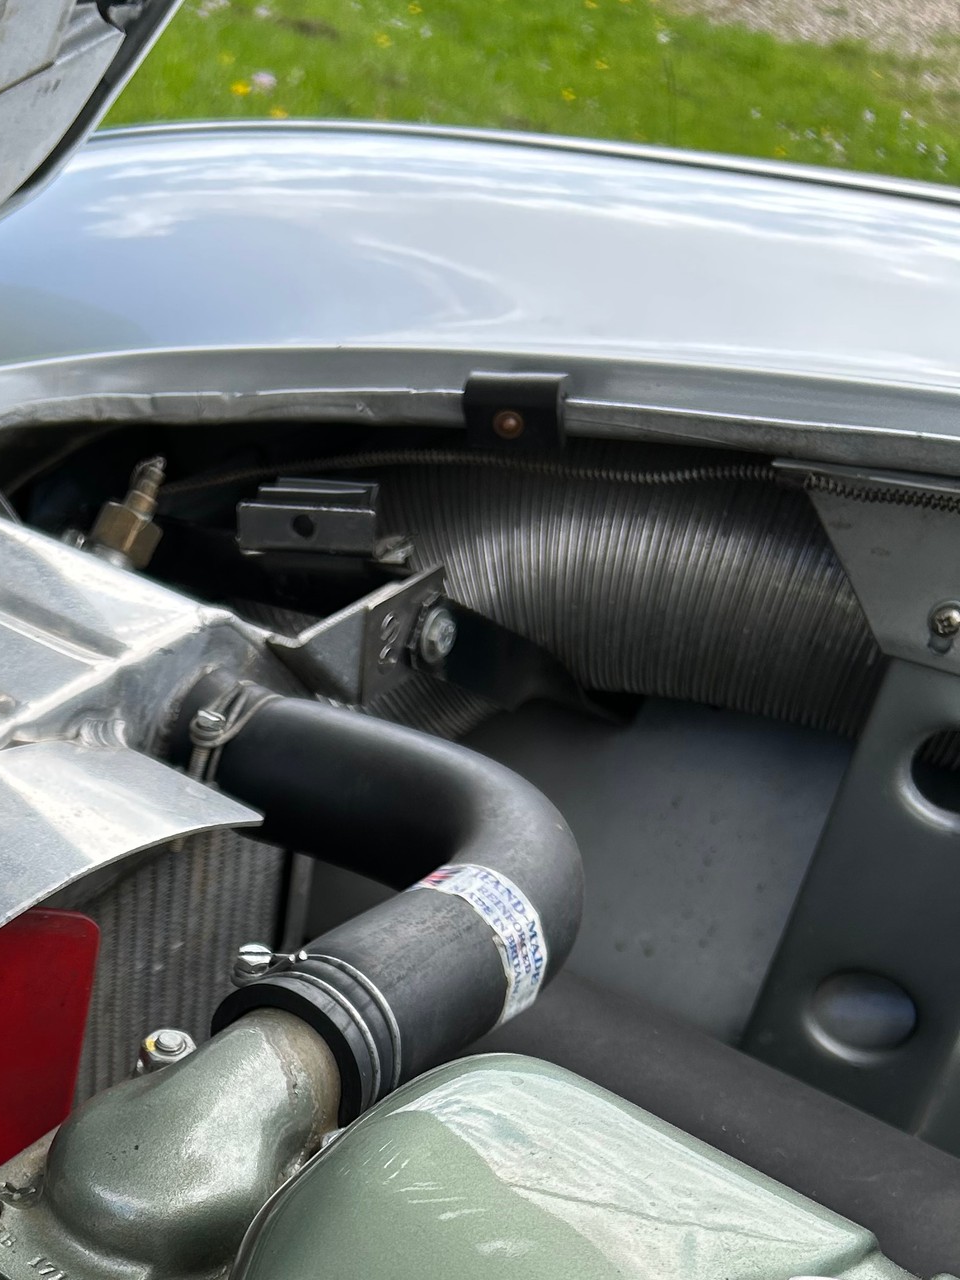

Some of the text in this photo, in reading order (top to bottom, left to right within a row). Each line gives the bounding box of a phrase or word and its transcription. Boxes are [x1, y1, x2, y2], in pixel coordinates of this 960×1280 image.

[478, 886, 531, 974] REINFORCED
[493, 918, 508, 932] IN
[506, 934, 522, 994] BRITAIN
